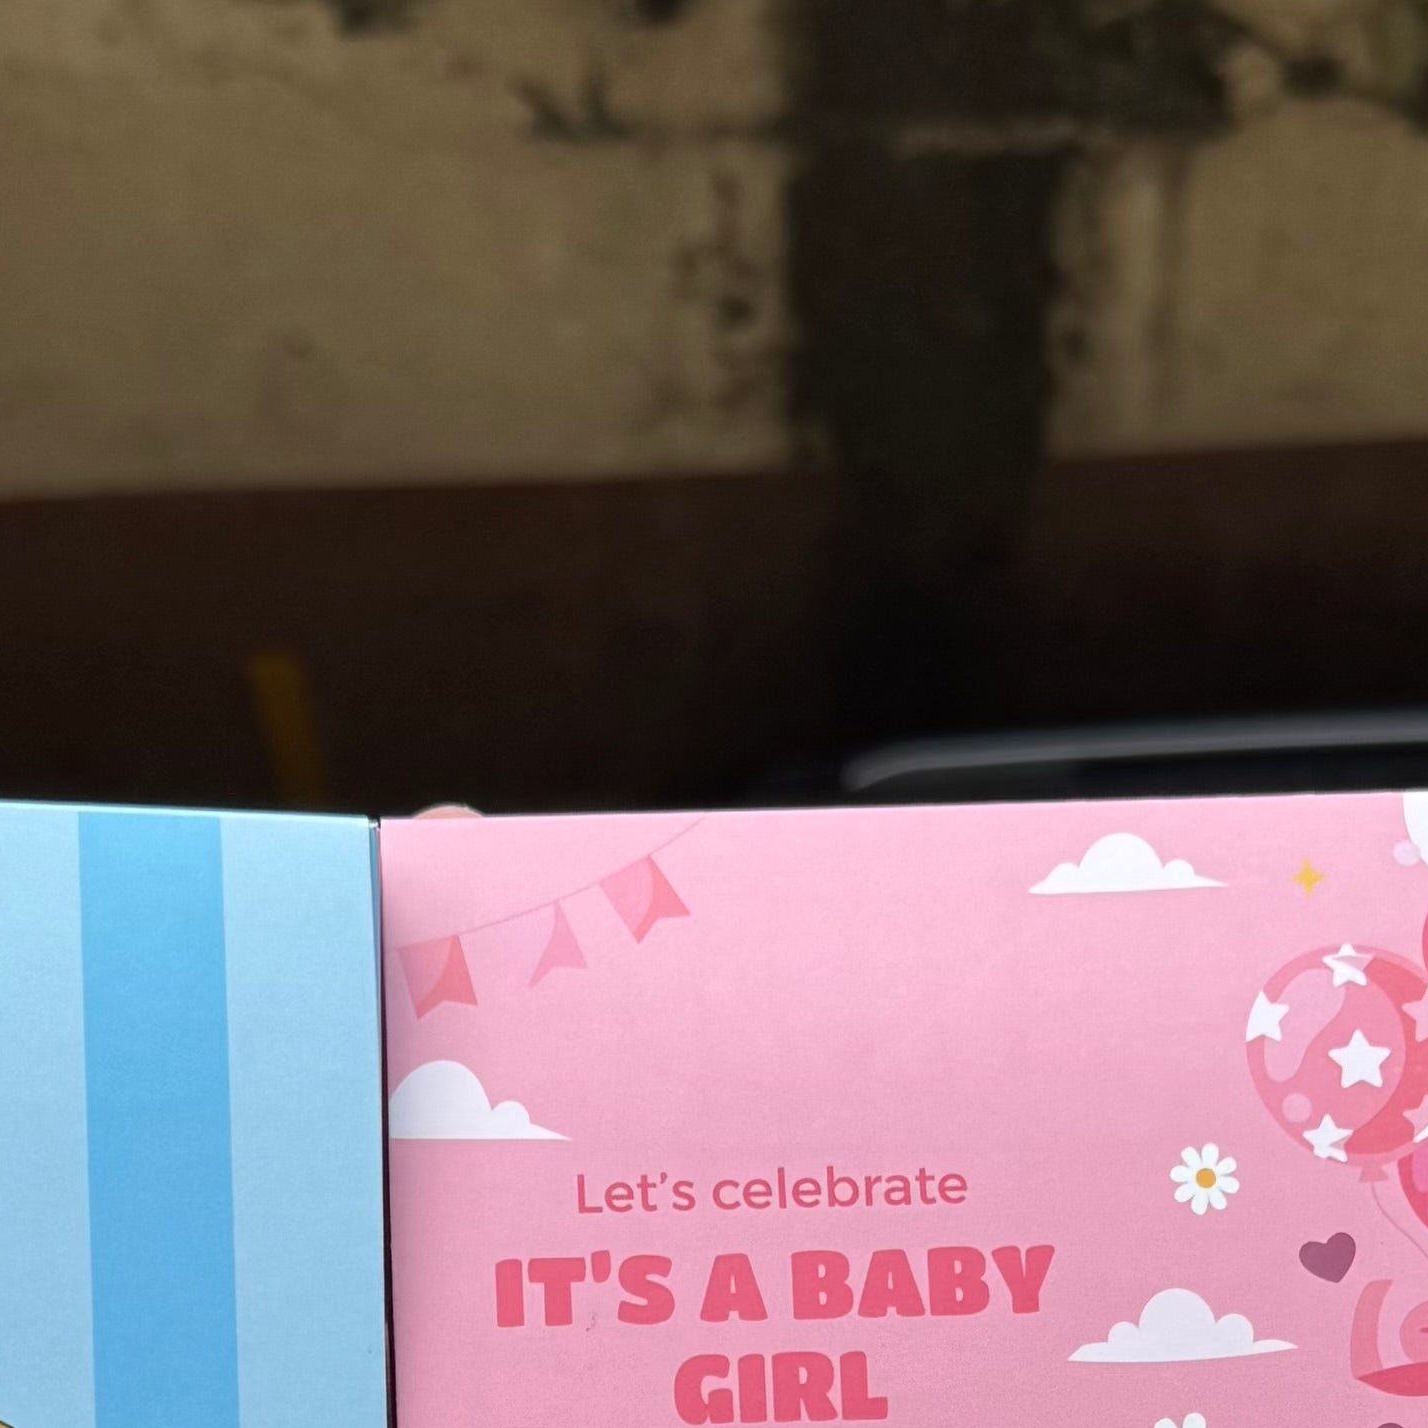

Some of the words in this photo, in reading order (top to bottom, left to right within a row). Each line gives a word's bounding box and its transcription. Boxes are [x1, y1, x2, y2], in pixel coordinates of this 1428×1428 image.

[577, 1172, 696, 1214] Let's
[712, 1166, 968, 1210] celebrate
[495, 1250, 675, 1327] IT'S
[700, 1253, 768, 1322] A
[791, 1245, 1055, 1321] BABY
[673, 1351, 888, 1425] GIRL
